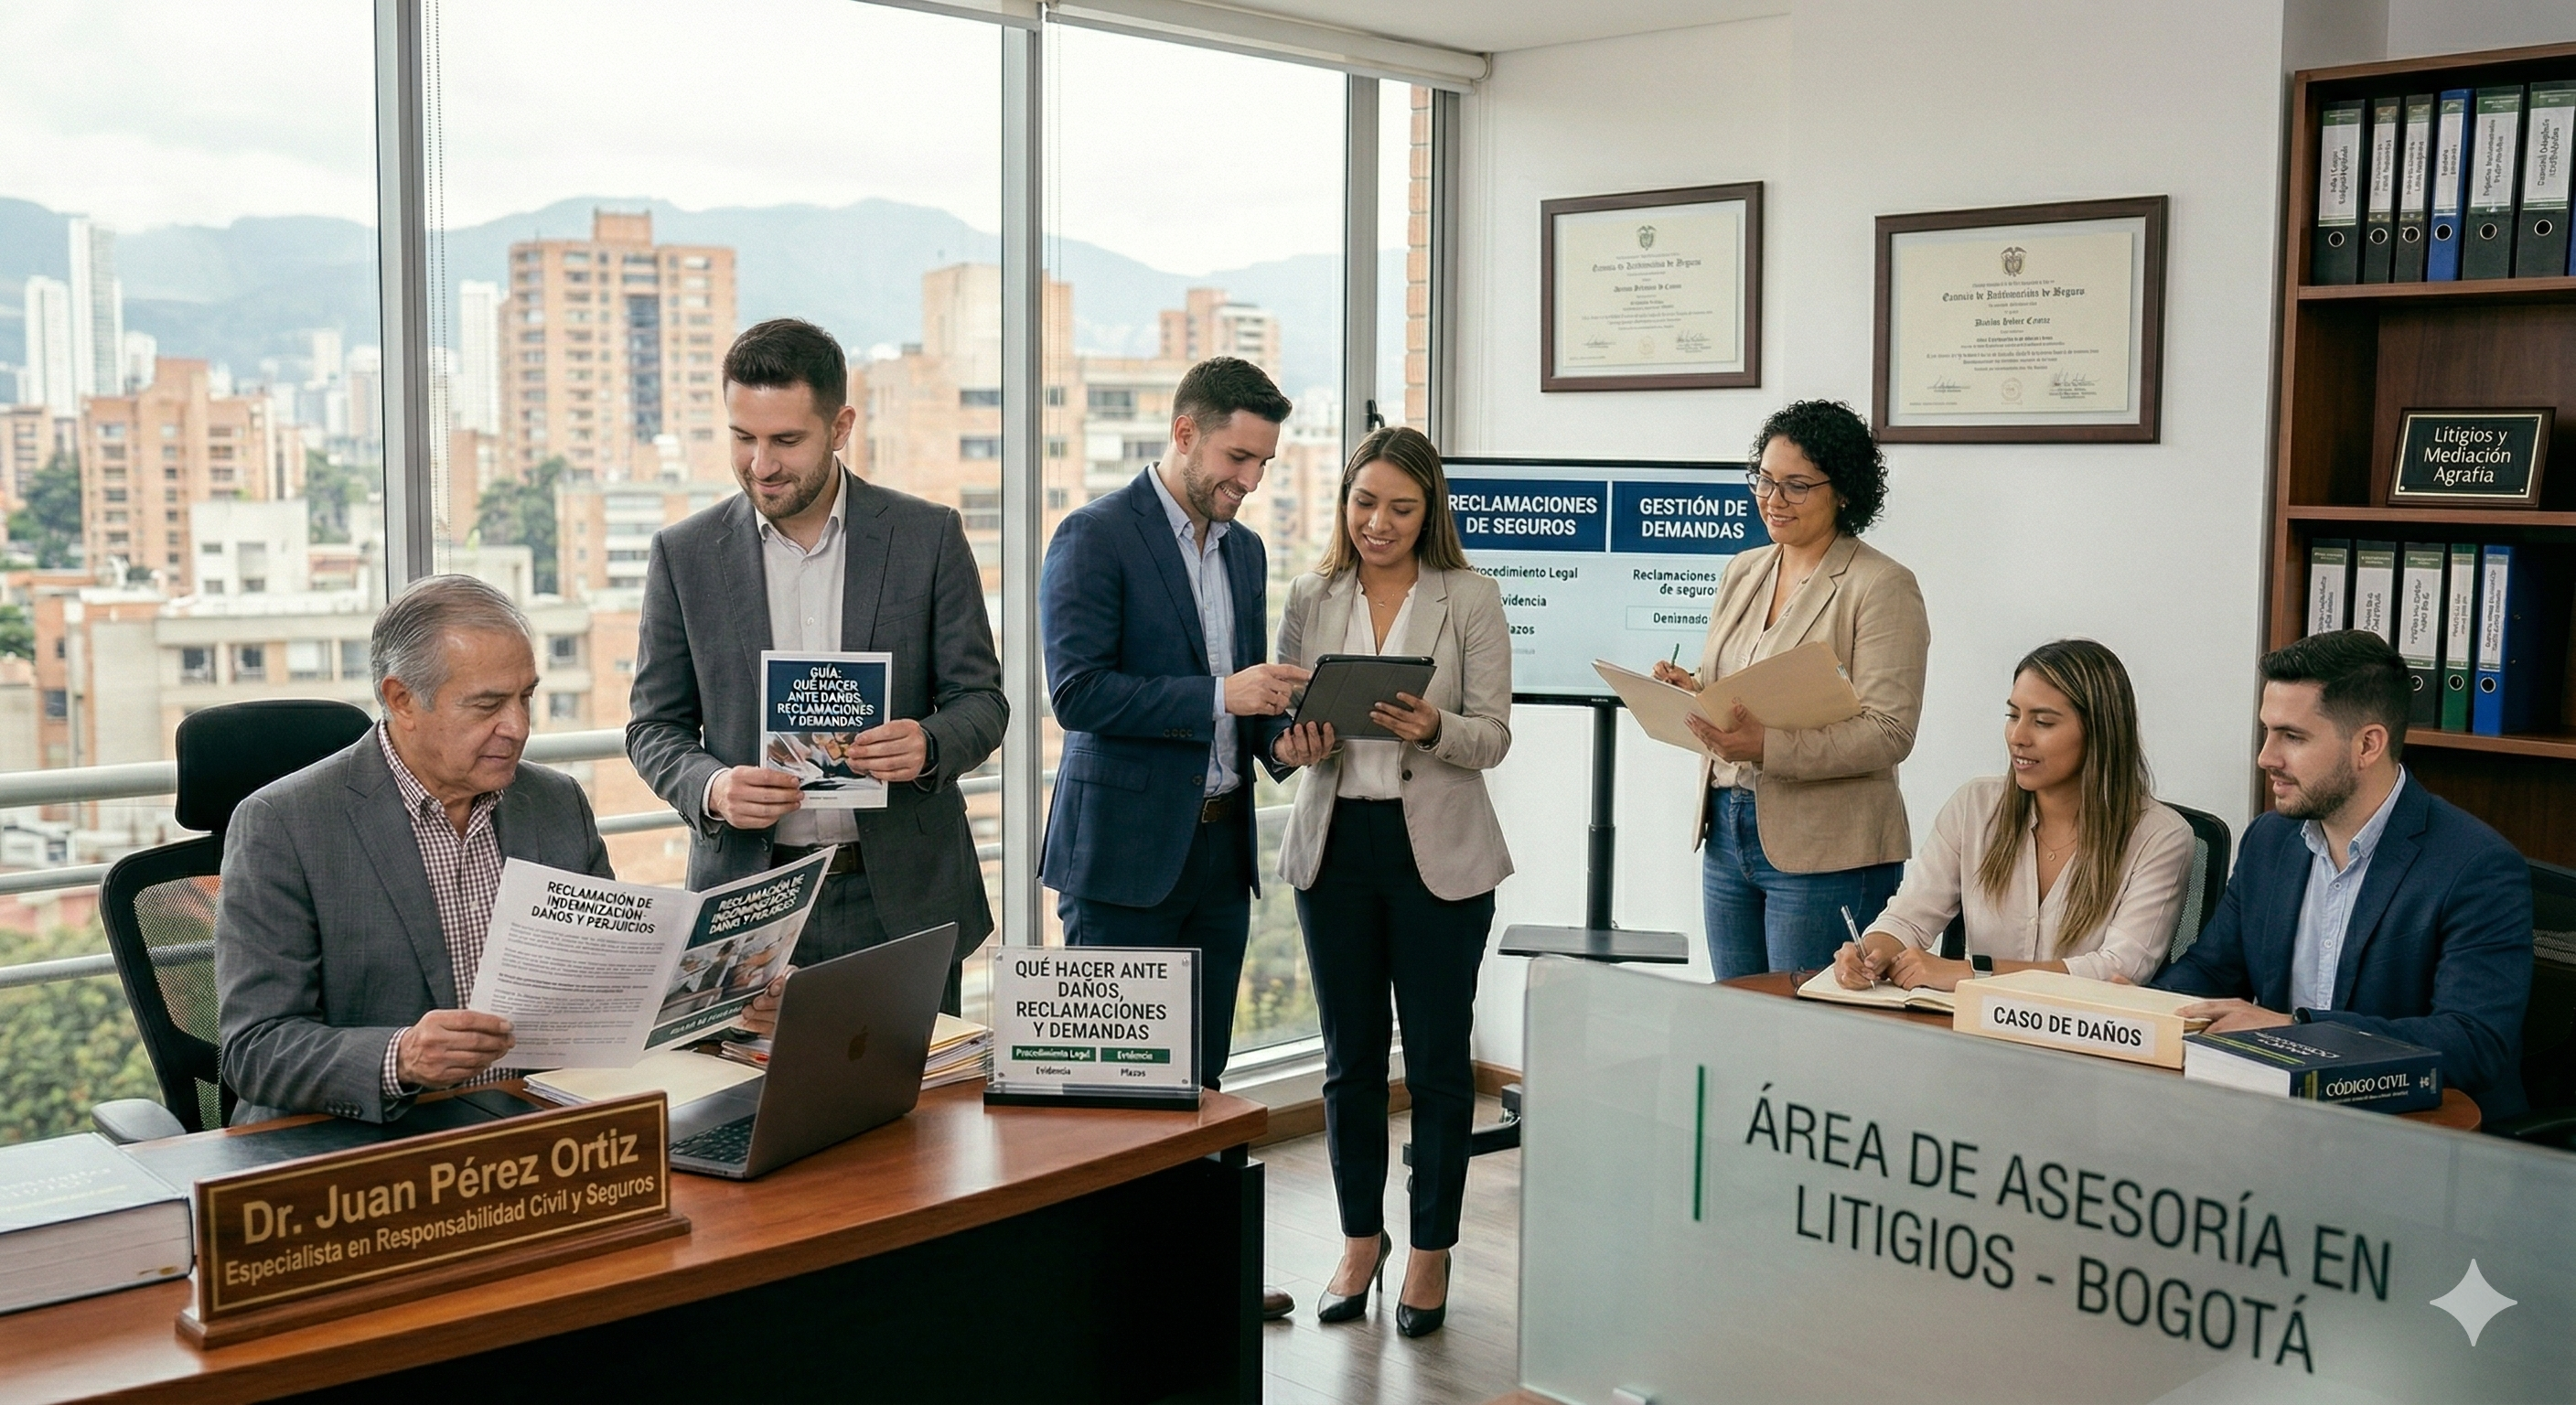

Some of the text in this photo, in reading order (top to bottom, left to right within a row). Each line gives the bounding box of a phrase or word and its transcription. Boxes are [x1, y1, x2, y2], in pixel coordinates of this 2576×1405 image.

[2497, 431, 2508, 446] y
[2423, 446, 2511, 464] Mediación
[2433, 466, 2495, 487] Agrafia
[1448, 494, 1598, 514] RECLAMACIONES
[1639, 495, 1748, 517] GESTIÓN DE
[1465, 517, 1576, 535] DE SEGUROS
[1641, 520, 1745, 539] DEMANDAS
[1549, 567, 1578, 581] Legal
[1633, 569, 1716, 582] Reclamaciones
[1500, 594, 1547, 606] videncia
[1659, 584, 1718, 598] de seguro
[819, 680, 859, 692] HACER
[787, 692, 820, 702] ANTE
[777, 702, 875, 715] RECLAMACIONES
[787, 714, 864, 727] Y DEMANDAS
[547, 881, 654, 908] RECLAMACIÓN DE
[577, 915, 585, 925] Y
[1015, 957, 1168, 979] QUÉ HACER ANTE
[1058, 978, 1123, 1003] DAÑOS,
[1016, 1001, 1167, 1020] RECLAMACIONES
[1033, 1022, 1150, 1040] Y DEMANDAS
[1993, 1006, 2142, 1046] CASO DE DAÑOS
[2325, 1073, 2410, 1097] CÓDIGO CIVIL
[242, 1128, 639, 1245] Dr. Juan Pérez Ortiz
[1745, 1082, 2392, 1302] ÁREA DE ASESORÍA EN
[225, 1175, 655, 1287] Especialista en Responsabilidad Civil y Seguros
[1797, 1184, 2015, 1291] LITIGIOS
[2077, 1254, 2315, 1375] BOGOTÁ
